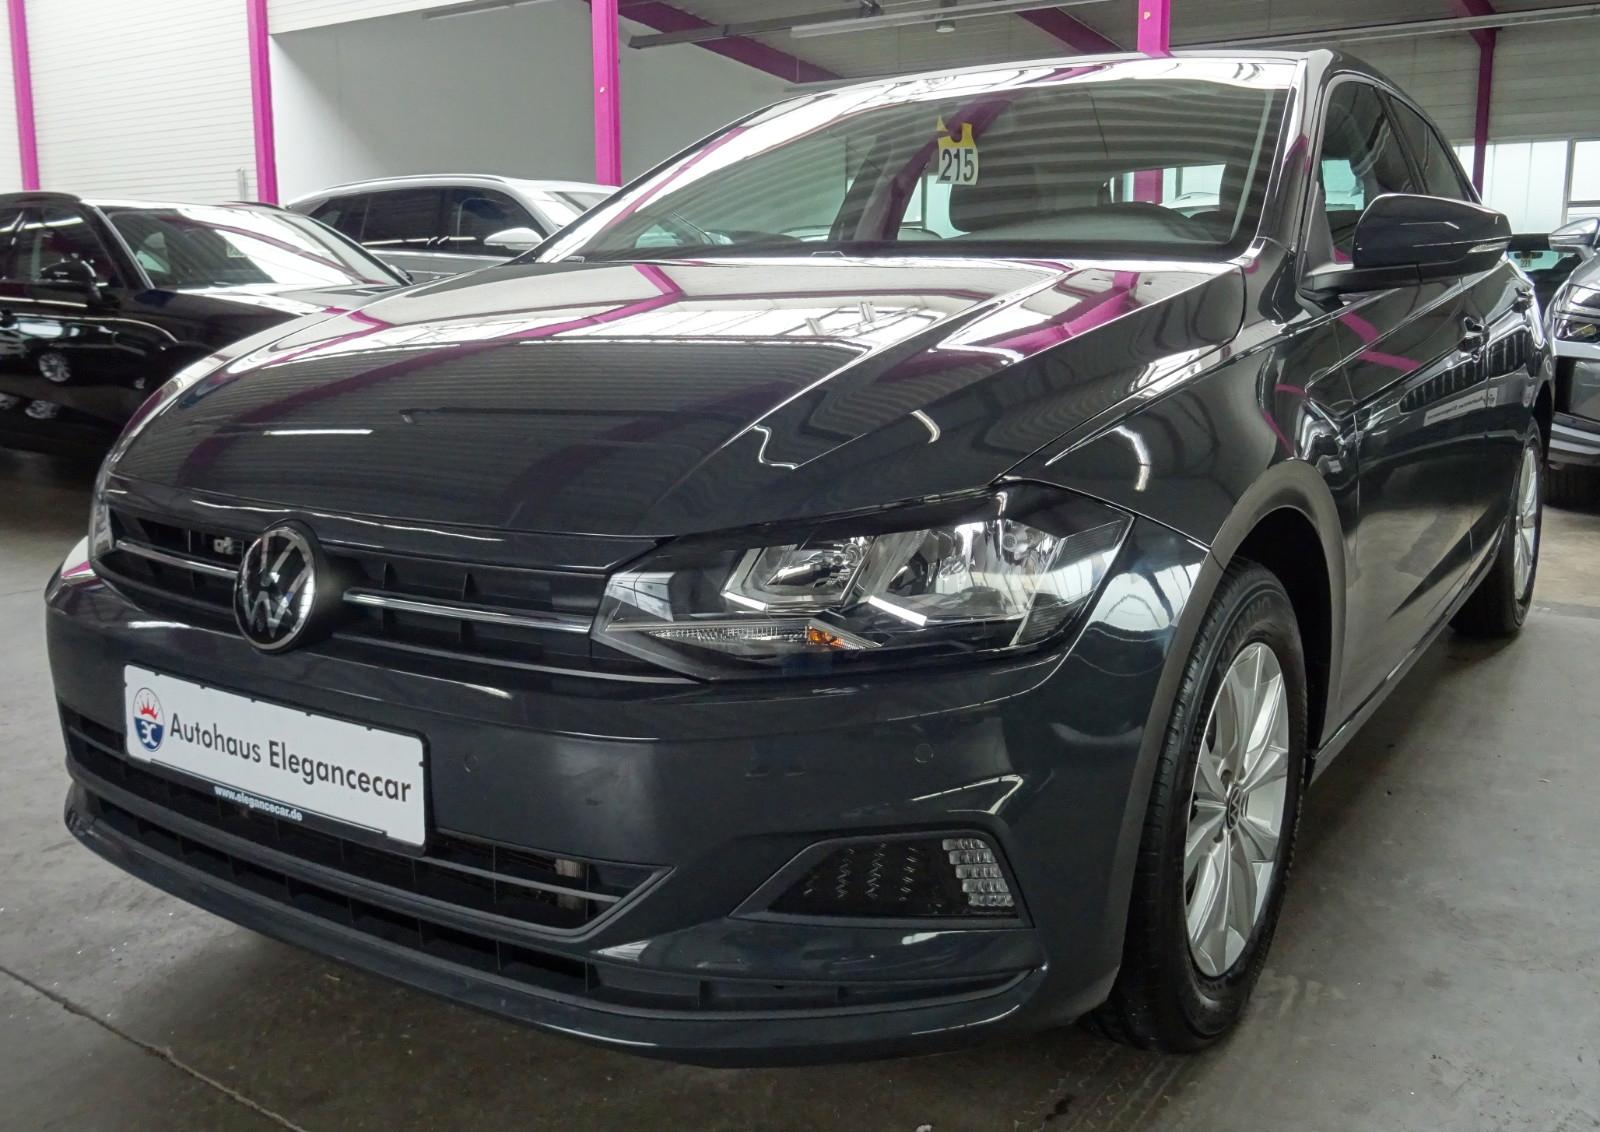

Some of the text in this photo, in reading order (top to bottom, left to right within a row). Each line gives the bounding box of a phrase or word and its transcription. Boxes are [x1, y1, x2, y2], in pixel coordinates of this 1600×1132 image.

[940, 148, 975, 182] 215
[169, 713, 412, 802] Autohaus Elegancecar
[213, 786, 303, 822] www.elegancecar.de
